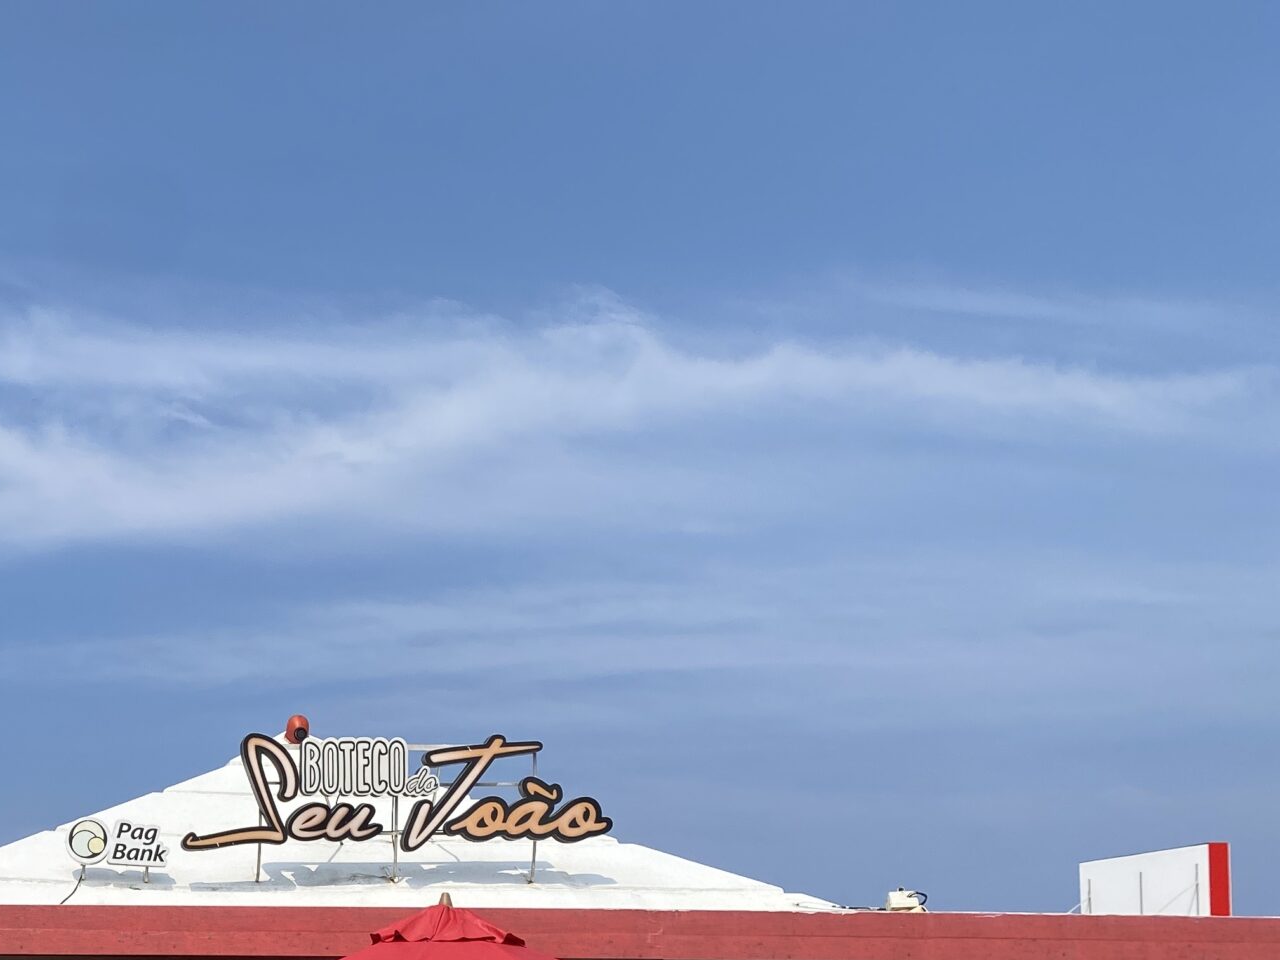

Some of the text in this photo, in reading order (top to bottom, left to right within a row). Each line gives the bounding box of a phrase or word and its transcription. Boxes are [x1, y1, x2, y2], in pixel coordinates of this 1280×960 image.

[302, 740, 438, 794] BOTECO do
[181, 733, 383, 850] Seu
[112, 843, 166, 862] Bank
[117, 822, 158, 845] Pag
